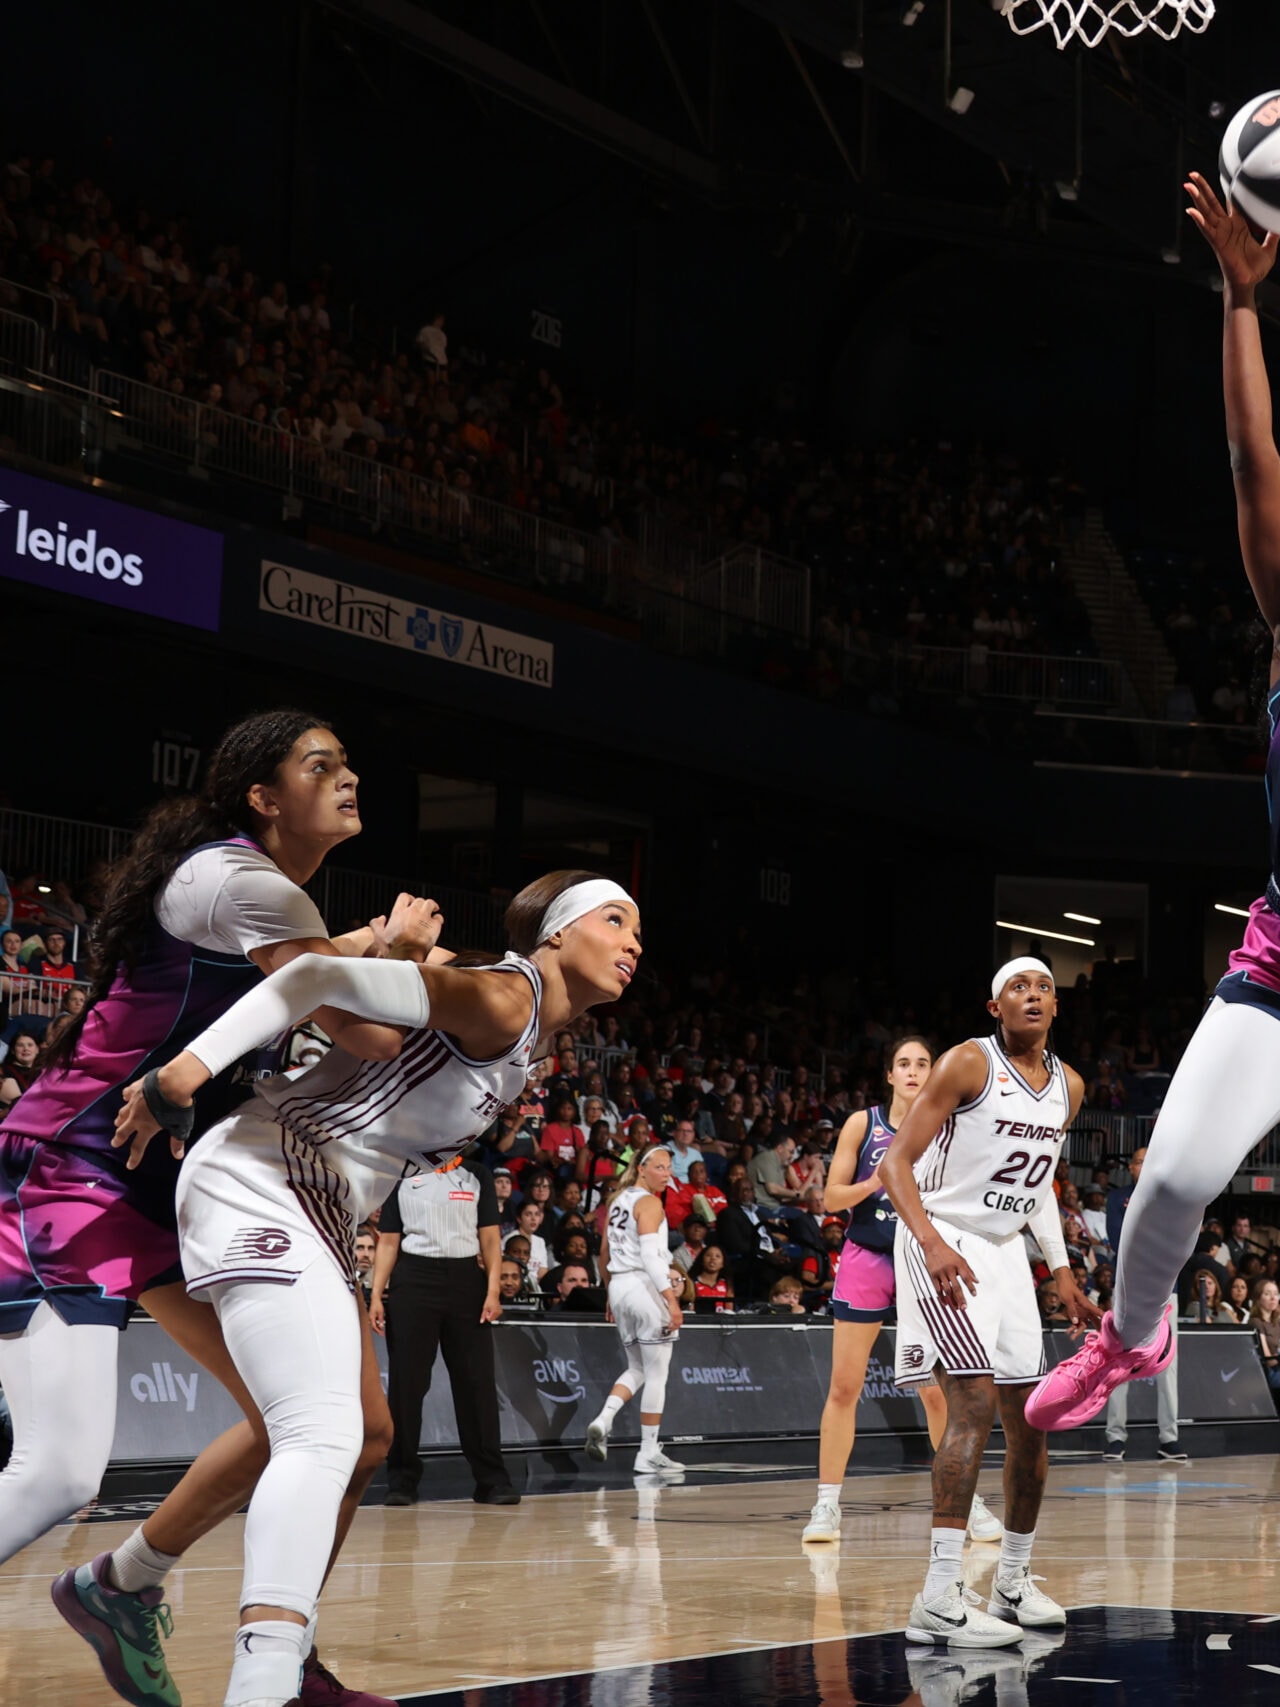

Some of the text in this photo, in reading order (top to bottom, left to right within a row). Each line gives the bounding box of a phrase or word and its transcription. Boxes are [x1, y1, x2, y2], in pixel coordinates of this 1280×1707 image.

[531, 309, 563, 349] 206
[16, 509, 143, 586] leidos
[263, 567, 552, 683] CareFirst Arena
[152, 739, 200, 790] 107
[989, 1150, 1054, 1188] 20
[608, 1206, 630, 1231] 22
[130, 1362, 199, 1412] ally
[533, 1359, 581, 1383] aws
